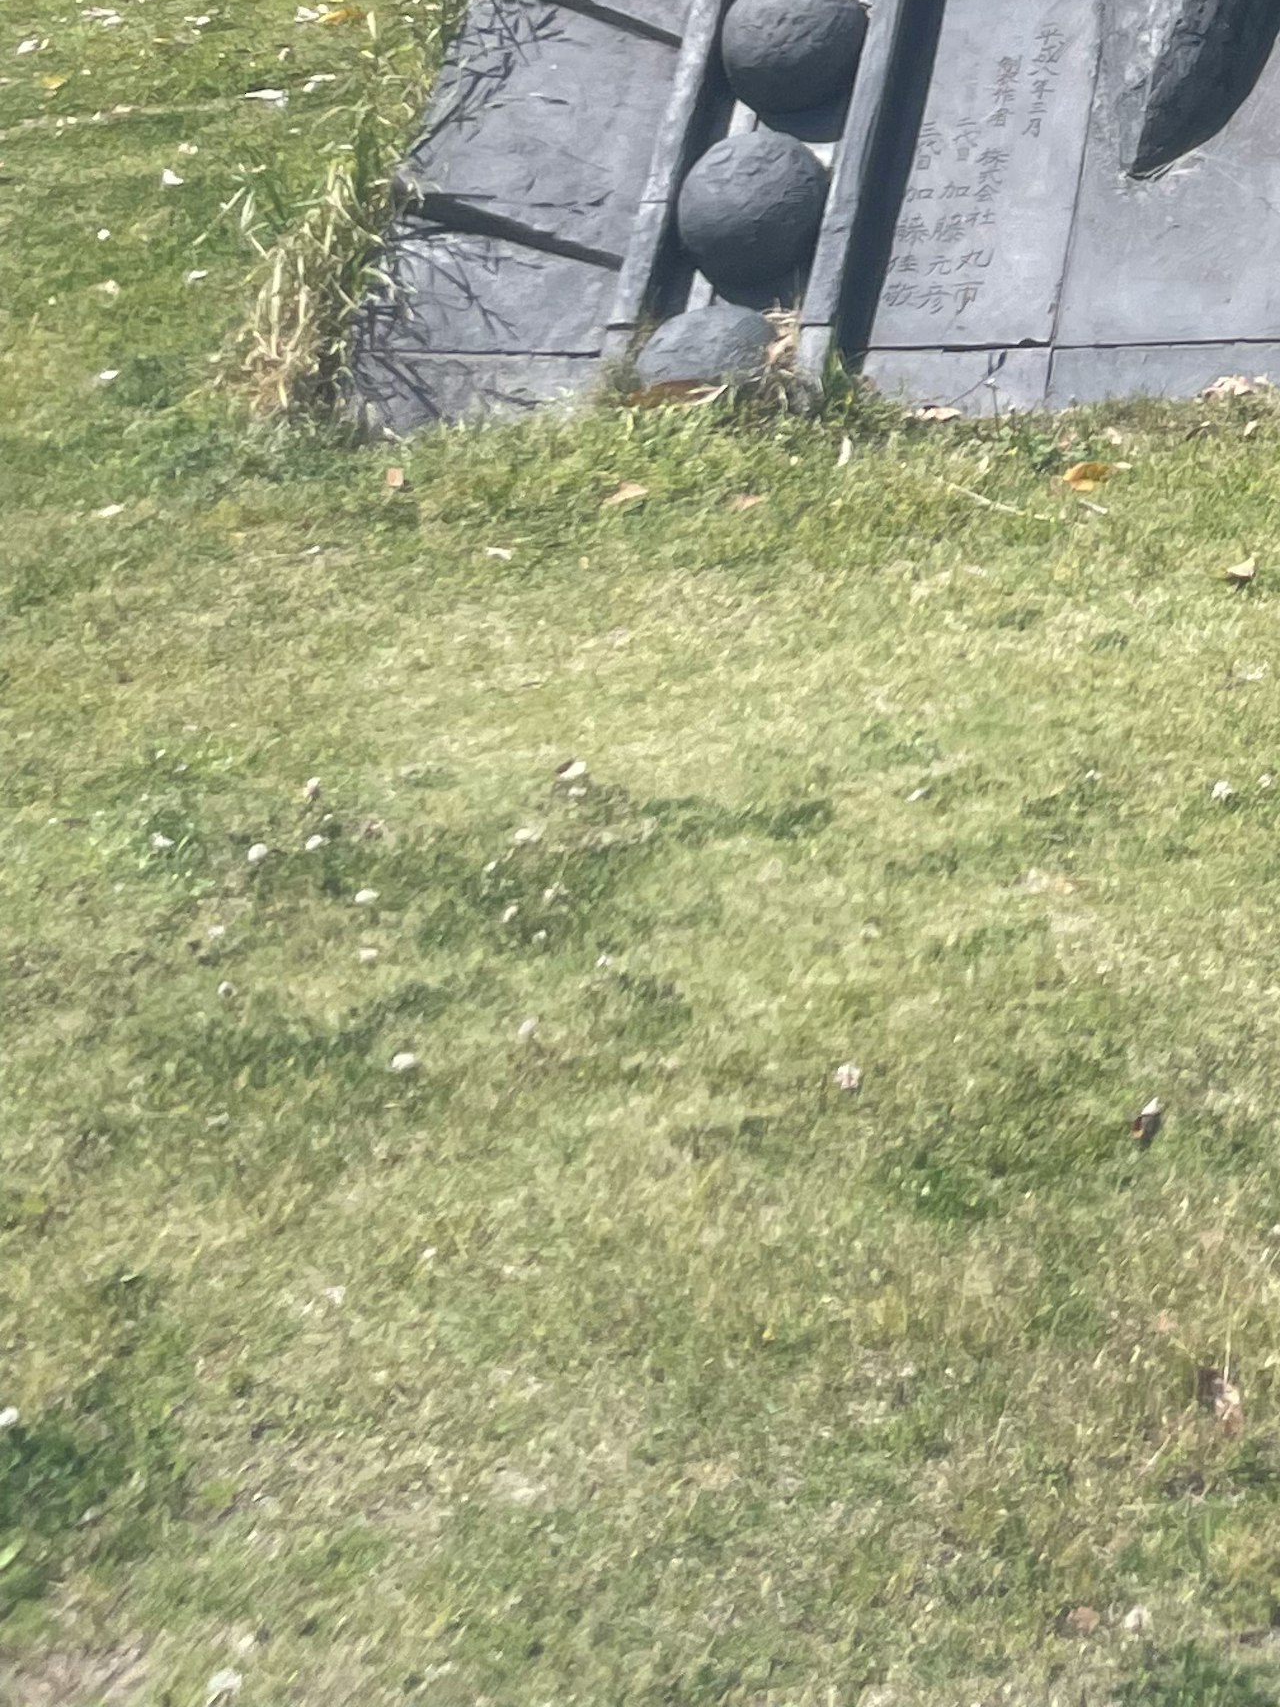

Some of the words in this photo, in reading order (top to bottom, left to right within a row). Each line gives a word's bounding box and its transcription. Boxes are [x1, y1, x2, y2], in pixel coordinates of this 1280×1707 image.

[987, 55, 1023, 127] 製作者
[1022, 22, 1065, 138] 平成八年三月
